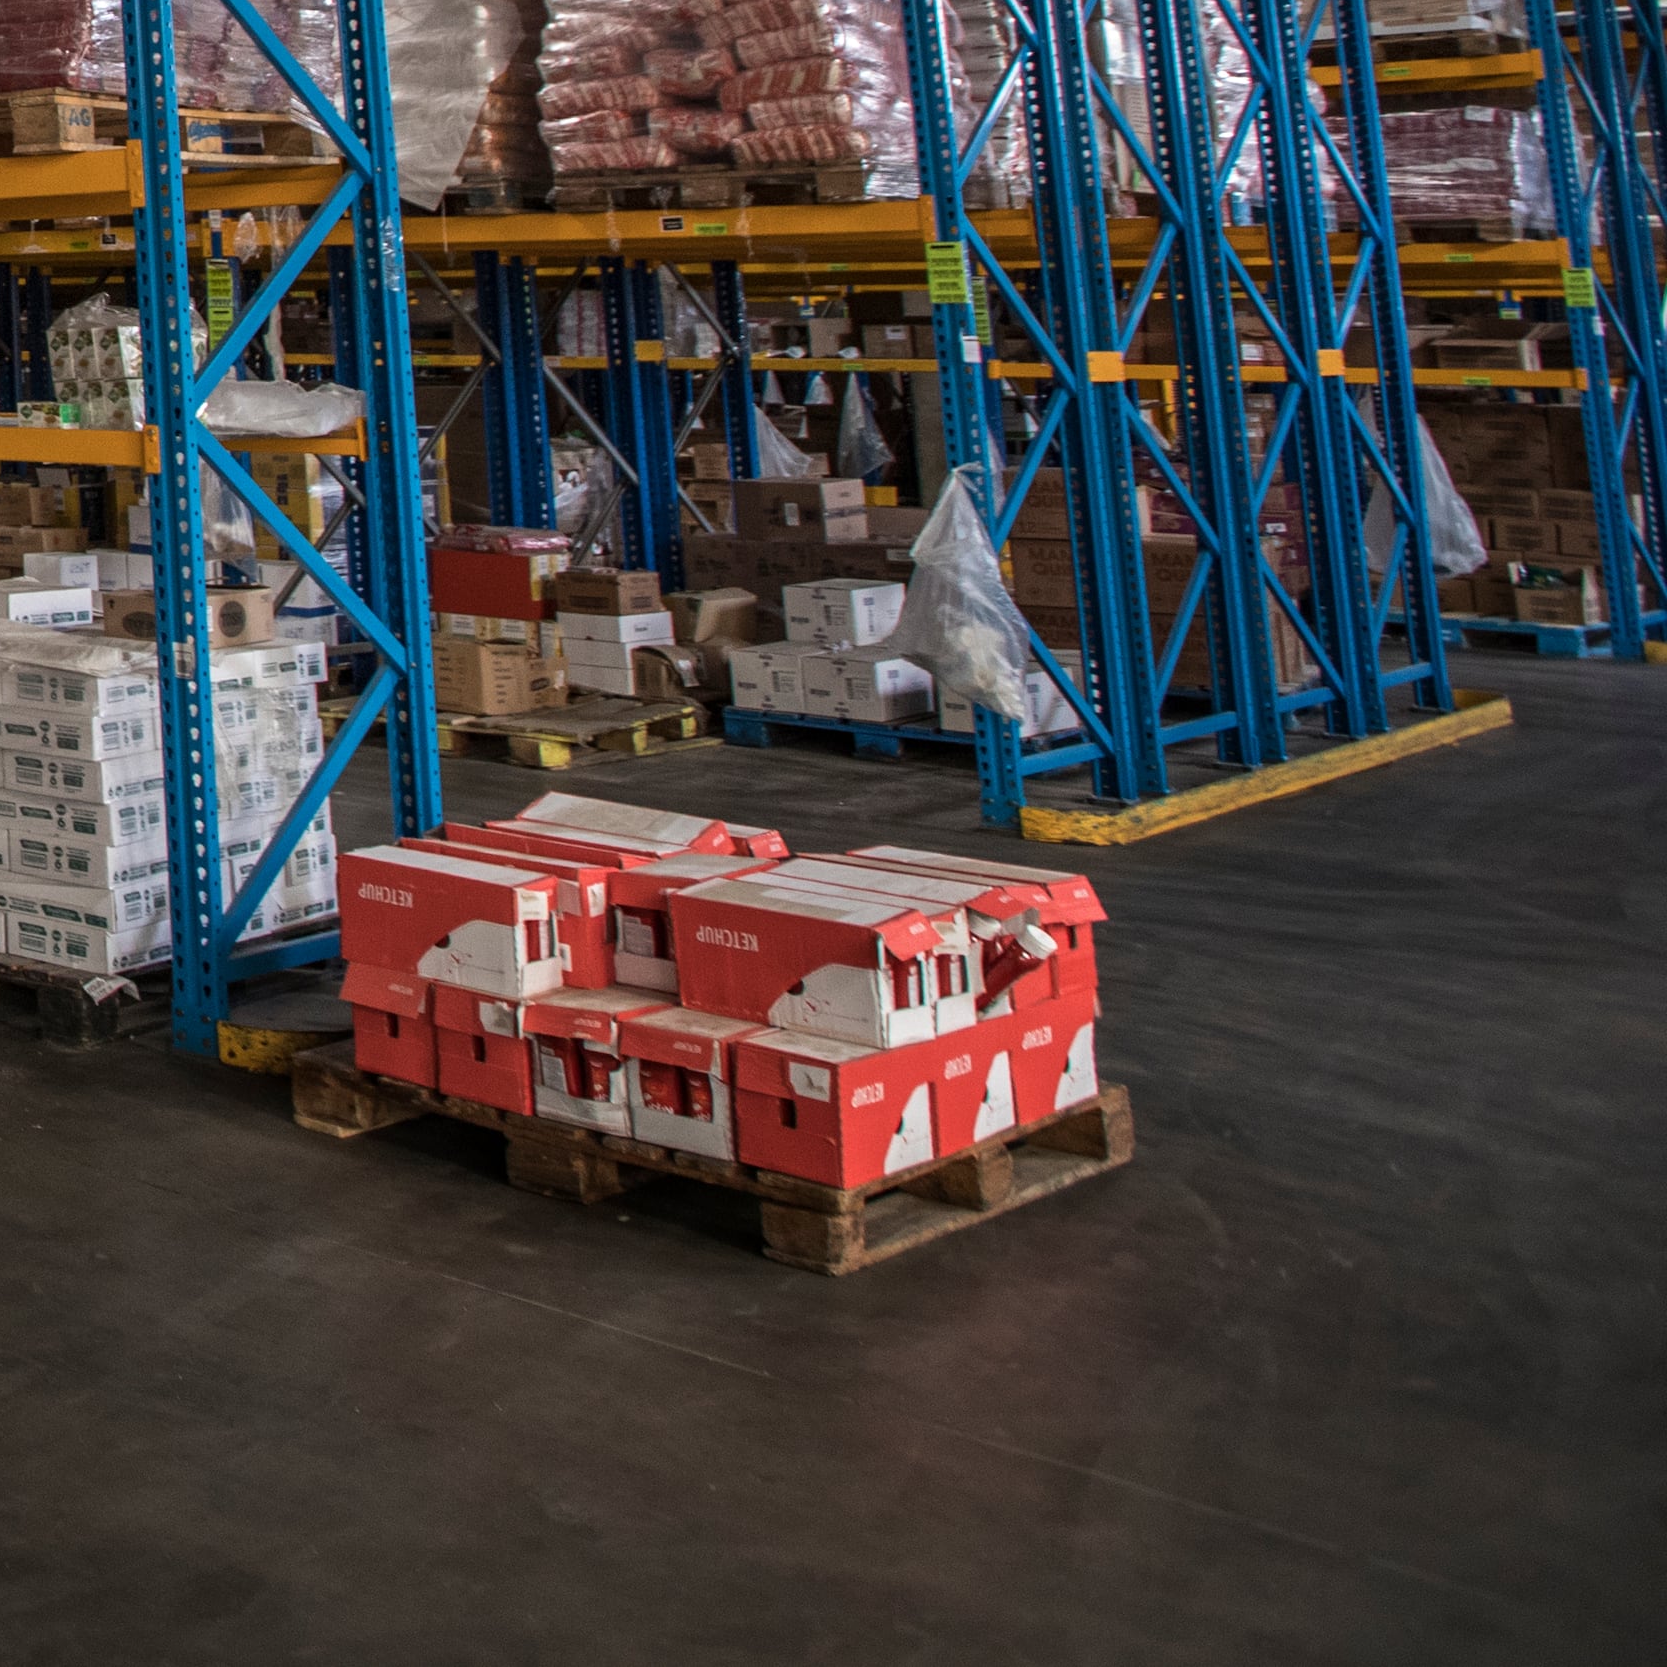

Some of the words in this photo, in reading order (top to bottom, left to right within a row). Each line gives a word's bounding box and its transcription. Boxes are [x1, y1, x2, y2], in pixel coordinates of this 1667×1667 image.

[68, 107, 92, 127] AG
[357, 882, 414, 909] KETCHUP
[695, 924, 759, 953] KETCHUP
